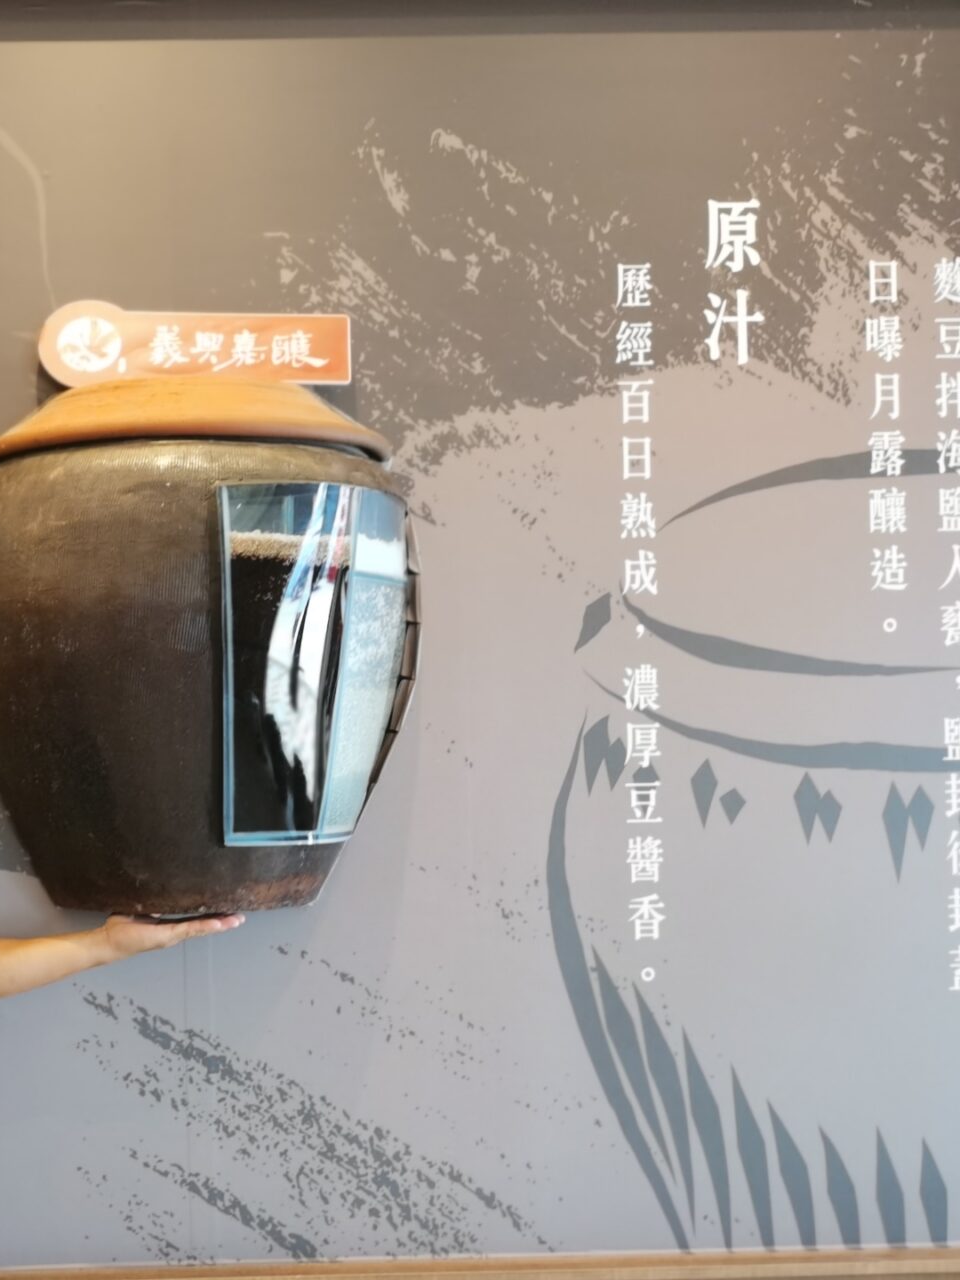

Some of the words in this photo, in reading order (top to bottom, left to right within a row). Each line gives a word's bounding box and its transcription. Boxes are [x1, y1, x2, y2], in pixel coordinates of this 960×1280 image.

[703, 197, 765, 367] 原汁
[865, 259, 909, 634] 日曝月露釀造。
[615, 262, 667, 983] 歷經百日熟成，濃厚豆醬香。
